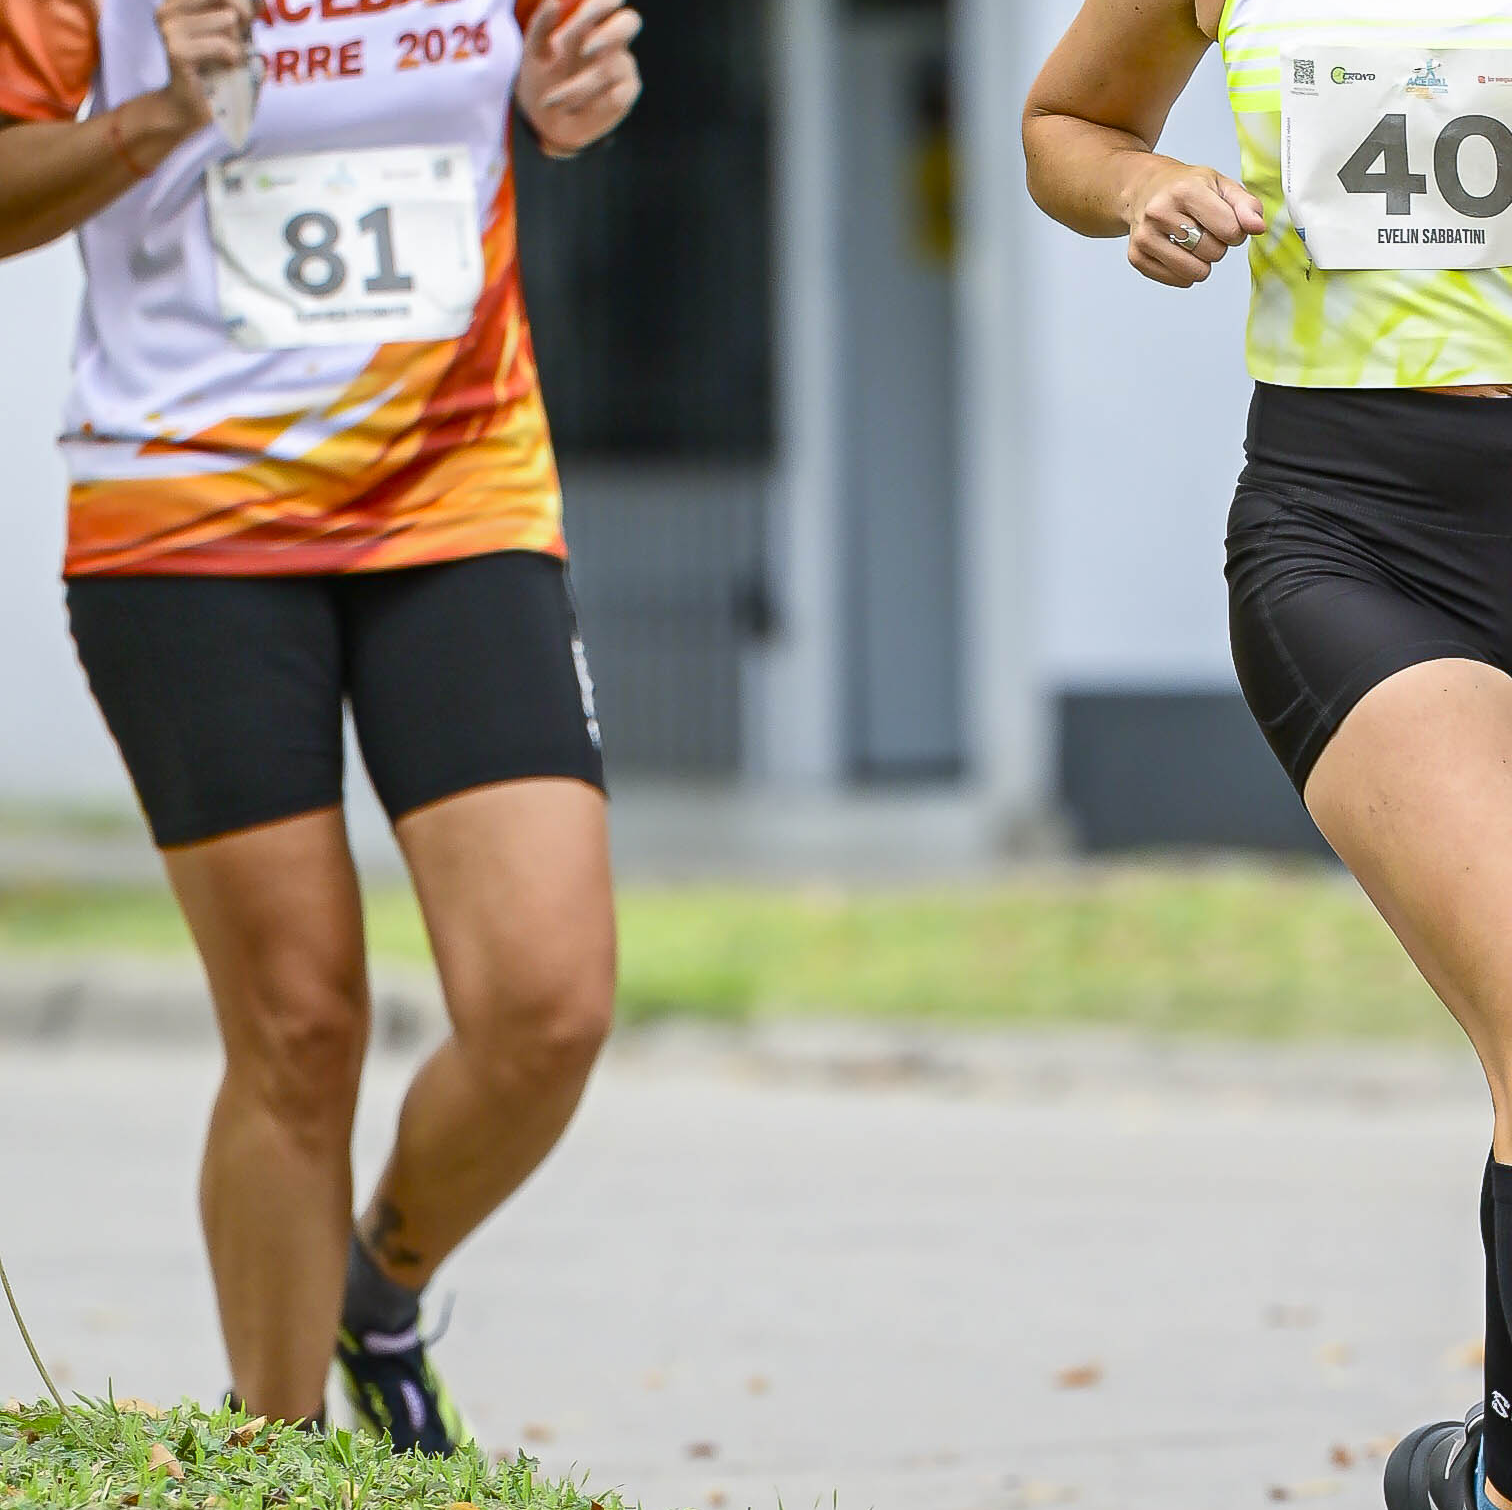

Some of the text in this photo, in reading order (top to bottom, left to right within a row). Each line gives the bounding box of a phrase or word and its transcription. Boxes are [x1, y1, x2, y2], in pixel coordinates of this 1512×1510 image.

[396, 20, 489, 71] 2026
[283, 206, 415, 297] 81
[1377, 228, 1486, 245] EVELIN SABBATINI
